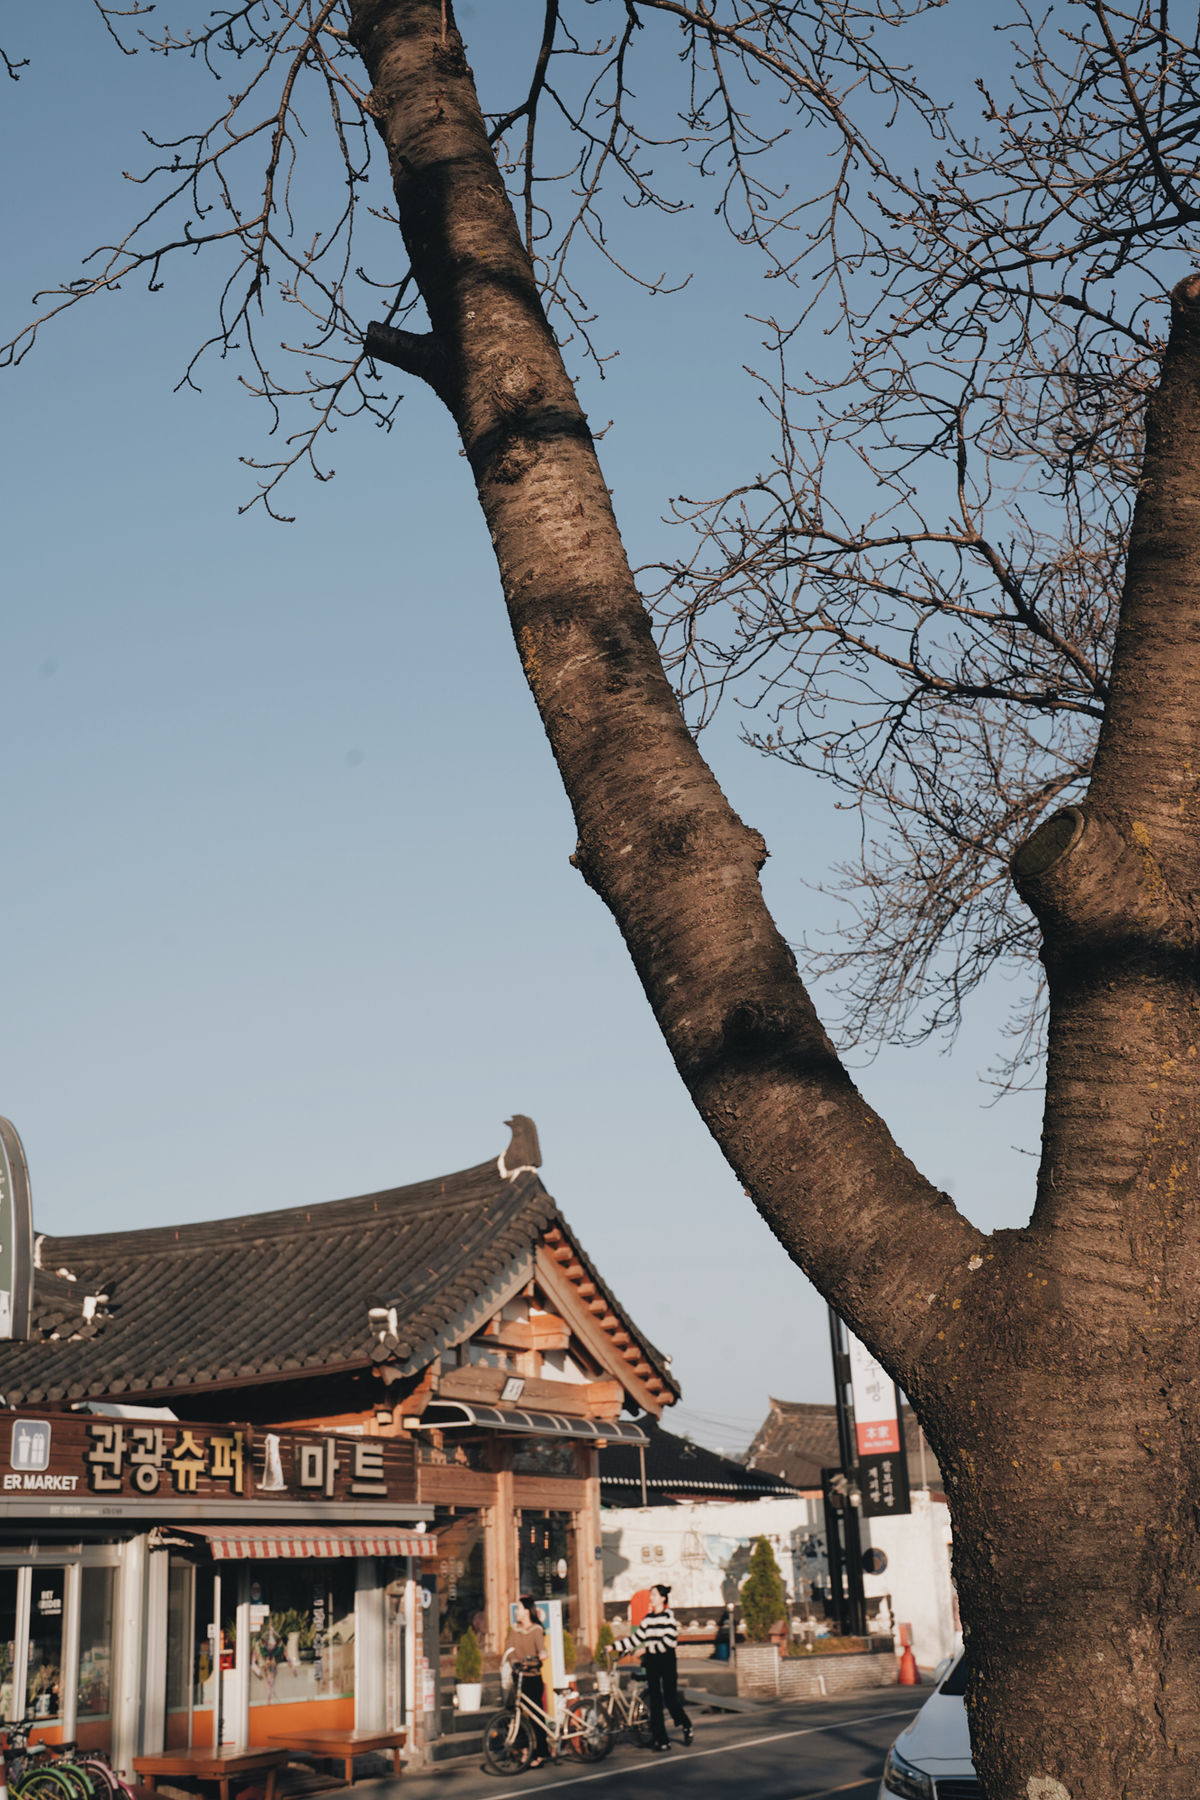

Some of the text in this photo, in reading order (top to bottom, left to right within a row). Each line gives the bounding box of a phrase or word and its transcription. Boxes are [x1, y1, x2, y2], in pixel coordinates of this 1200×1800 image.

[89, 1424, 387, 1496] 관광슈퍼 마트
[3, 1474, 78, 1491] ER MARKET
